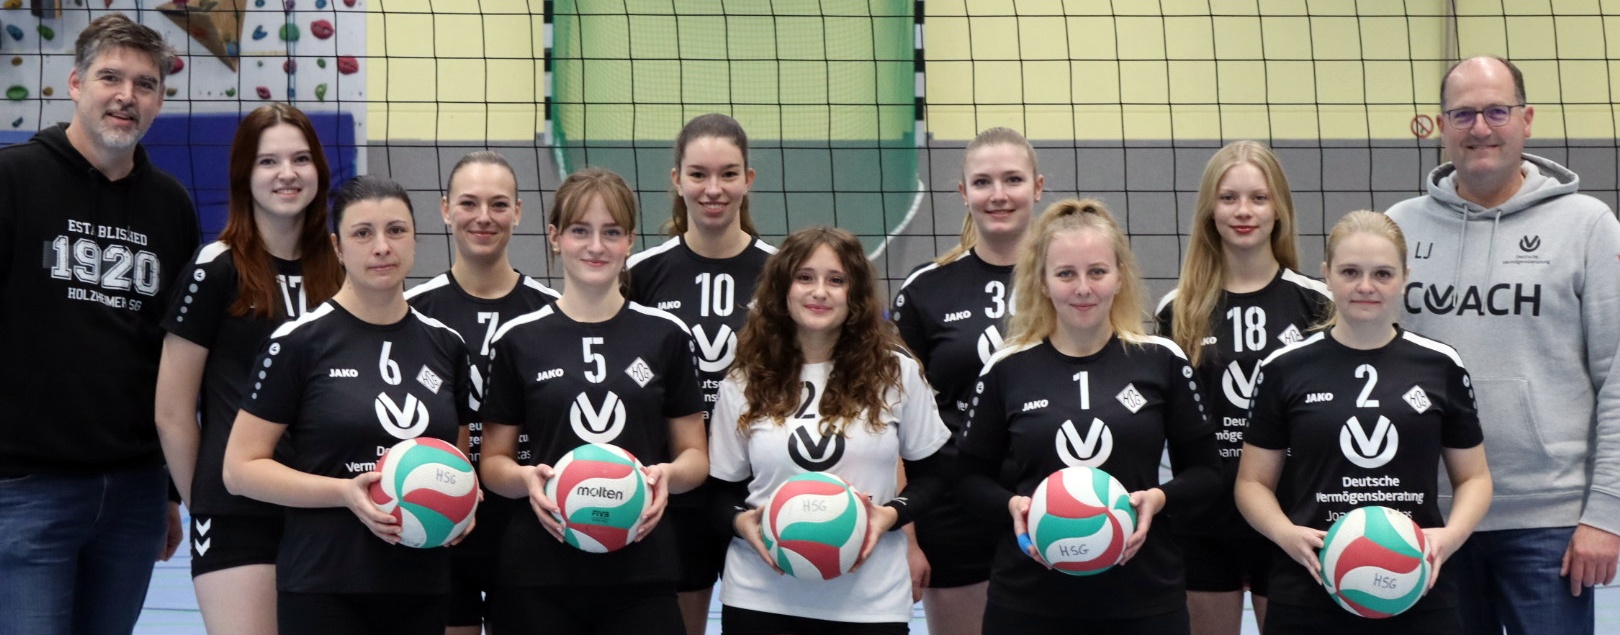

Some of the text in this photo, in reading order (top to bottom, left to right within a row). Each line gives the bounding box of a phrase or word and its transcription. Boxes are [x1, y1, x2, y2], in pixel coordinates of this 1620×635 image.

[1414, 241, 1434, 259] LJ
[51, 234, 160, 297] 1920
[276, 274, 307, 317] 17
[695, 272, 735, 317] 10
[128, 299, 142, 311] SG
[943, 310, 972, 323] JAKO
[477, 311, 499, 356] 7
[1226, 305, 1267, 353] 18
[379, 341, 402, 386] 6
[581, 337, 607, 384] 5
[329, 368, 359, 378] JAKO
[536, 368, 564, 382] JAKO
[1072, 371, 1090, 410] 1
[1354, 363, 1380, 408] 2
[1022, 399, 1049, 412] JAKO
[1305, 392, 1334, 403] JAKO
[436, 468, 457, 485] HSG
[1342, 475, 1400, 487] Deutsche
[576, 486, 624, 500] molten
[591, 510, 610, 518] FIVB
[802, 500, 828, 512] HSG
[1059, 545, 1089, 557] HSG
[1373, 573, 1398, 589] HSG
